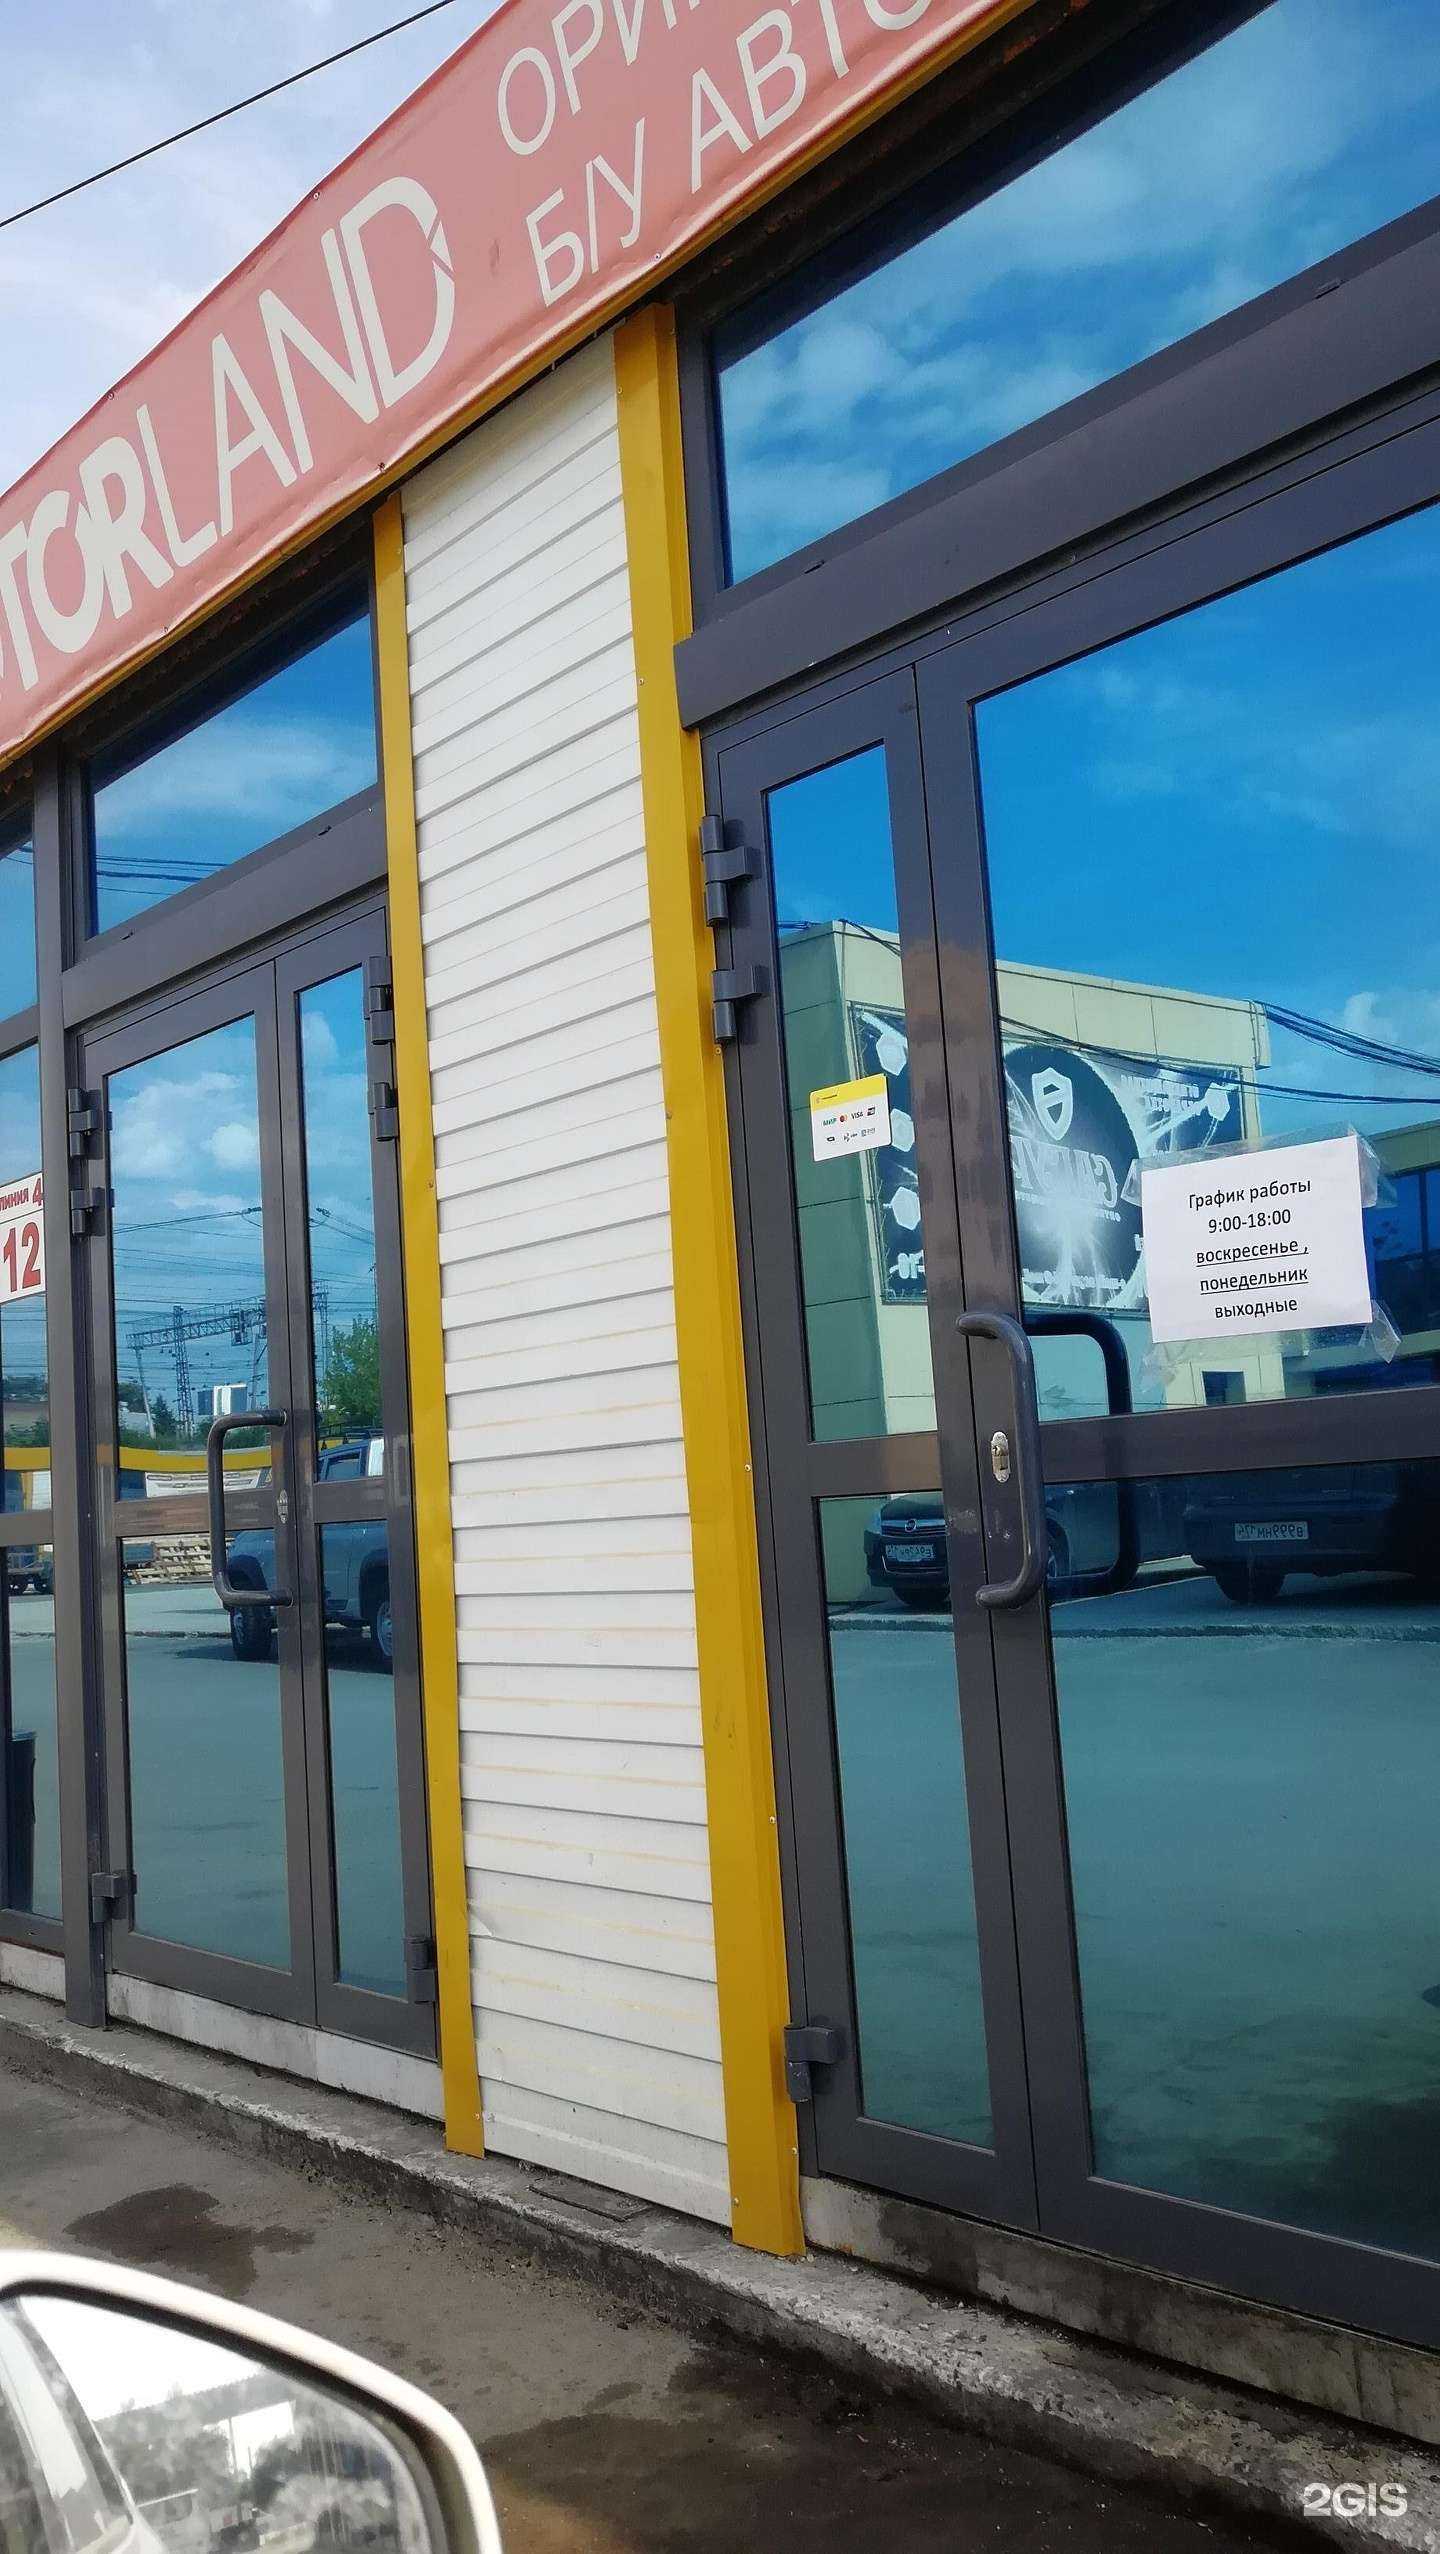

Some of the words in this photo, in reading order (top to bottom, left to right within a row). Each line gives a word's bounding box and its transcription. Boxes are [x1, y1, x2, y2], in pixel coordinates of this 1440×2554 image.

[525, 117, 646, 308] Б/У
[0, 176, 455, 692] TORLAND
[851, 1111, 864, 1120] VISA
[1189, 1188, 1245, 1211] График
[1250, 1179, 1311, 1203] работы
[1208, 1209, 1291, 1234] 9:00-18:00
[4, 1222, 41, 1292] 12
[1196, 1240, 1299, 1264] воскресенье
[1200, 1268, 1308, 1293] понедельник
[1215, 1298, 1298, 1319] выходные
